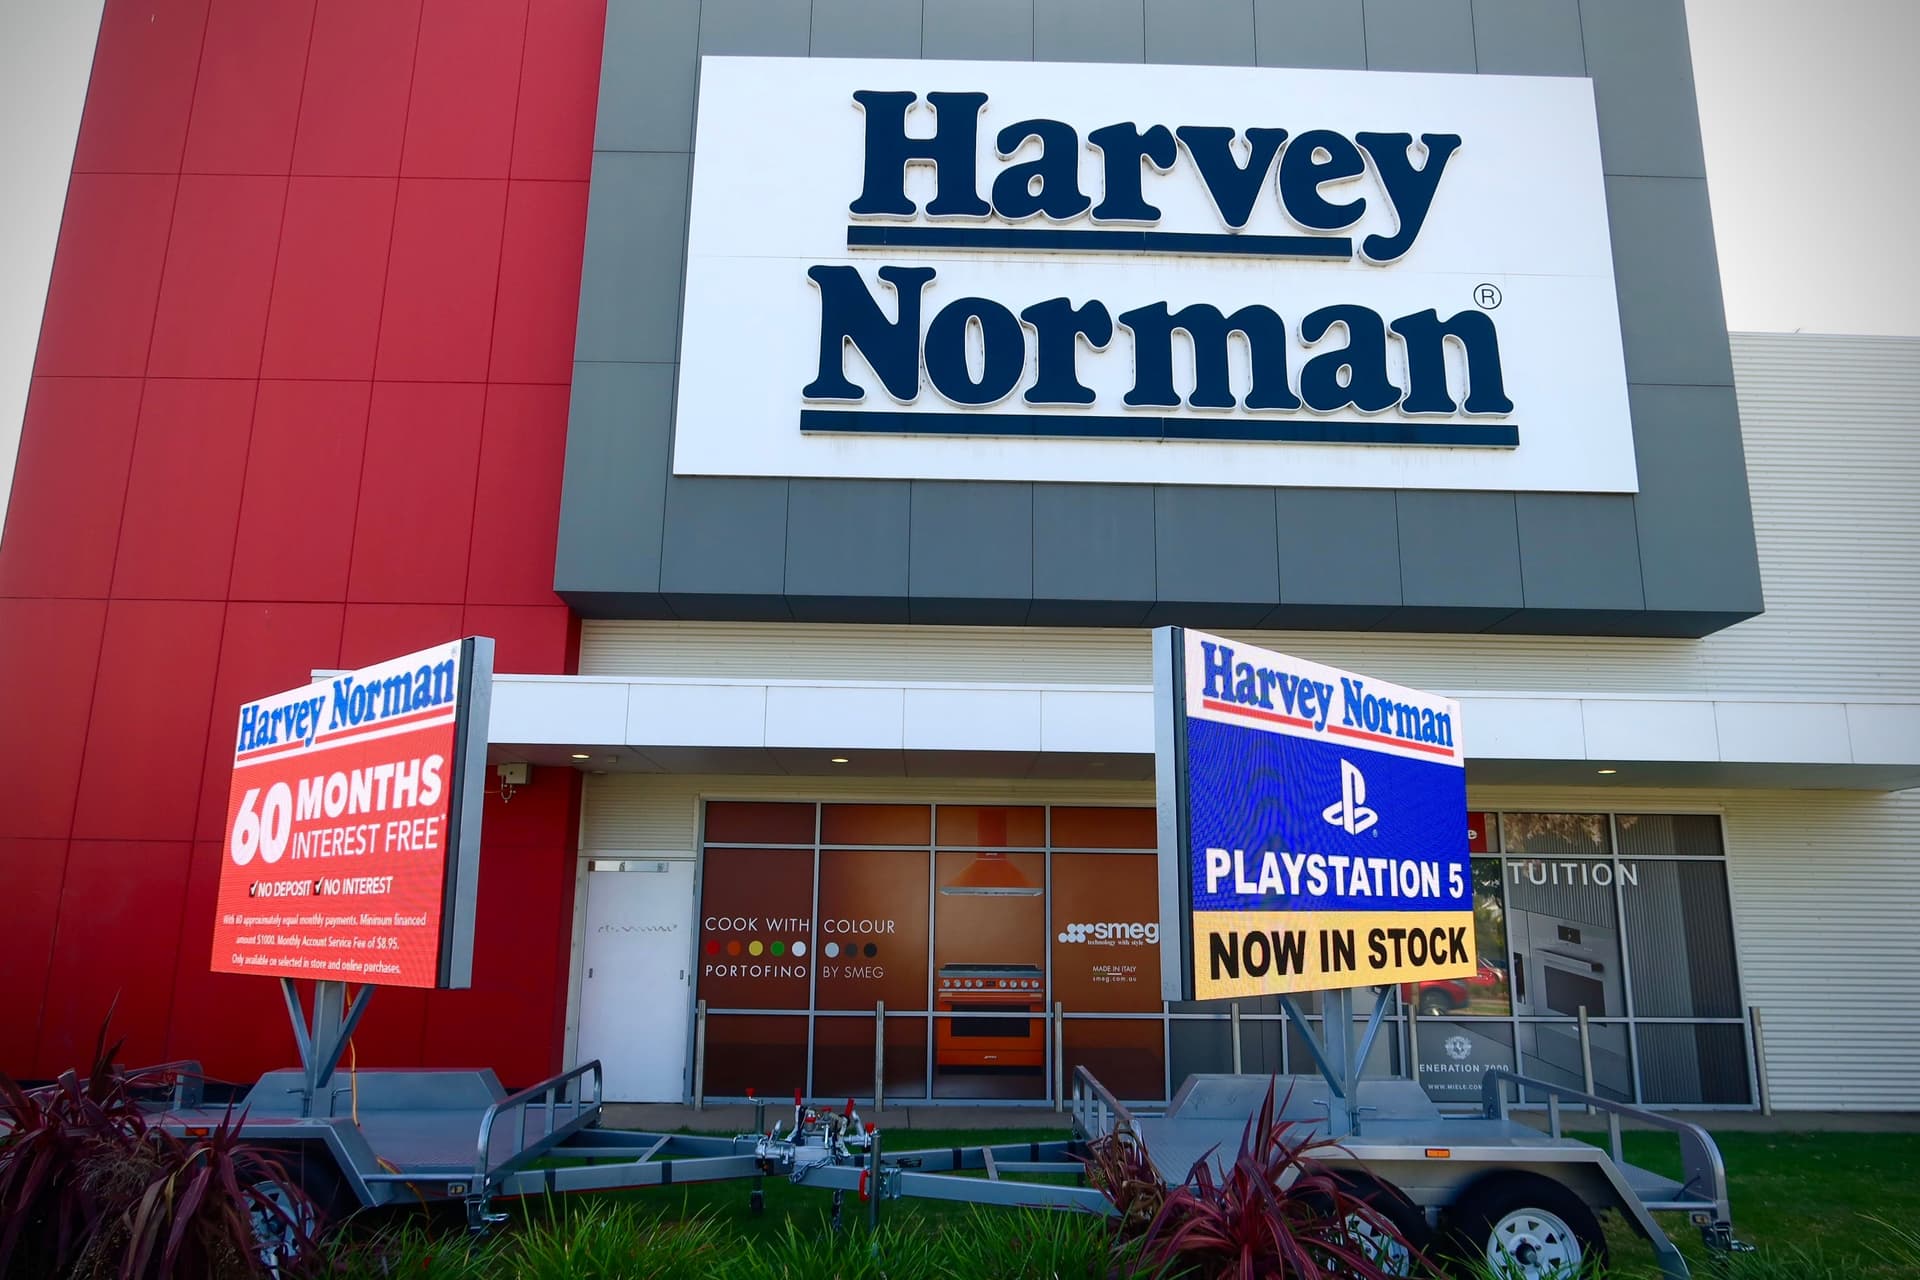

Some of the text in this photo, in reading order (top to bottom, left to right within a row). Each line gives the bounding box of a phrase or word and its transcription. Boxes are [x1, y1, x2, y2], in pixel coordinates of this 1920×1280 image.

[849, 88, 1462, 266] Harvey
[802, 264, 1514, 418] Norman
[237, 657, 455, 751] Harvey Norman
[1201, 640, 1454, 747] Harvey Norman
[296, 754, 444, 822] MONTHS
[230, 782, 294, 866] 60
[292, 824, 381, 860] INTEREST
[324, 876, 393, 895] NO INTEREST
[1206, 848, 1464, 898] PLAYSTATION 5
[258, 880, 312, 897] NO DEPOSIT
[324, 915, 358, 928] payments.
[359, 913, 392, 926] Minimum
[393, 912, 427, 926] financed
[705, 917, 896, 934] COOK WITH COLOUR
[1094, 922, 1160, 944] smeg
[277, 934, 301, 949] Monthly
[301, 935, 327, 947] Account
[328, 936, 352, 948] Service
[353, 936, 366, 949] Fee
[367, 936, 377, 949] of
[1209, 926, 1469, 980] NOW IN STOCK
[327, 957, 341, 970] and
[341, 958, 362, 972] online
[705, 964, 884, 979] PORTOFINO BY SMEG
[1418, 1063, 1480, 1073] ENERATION
